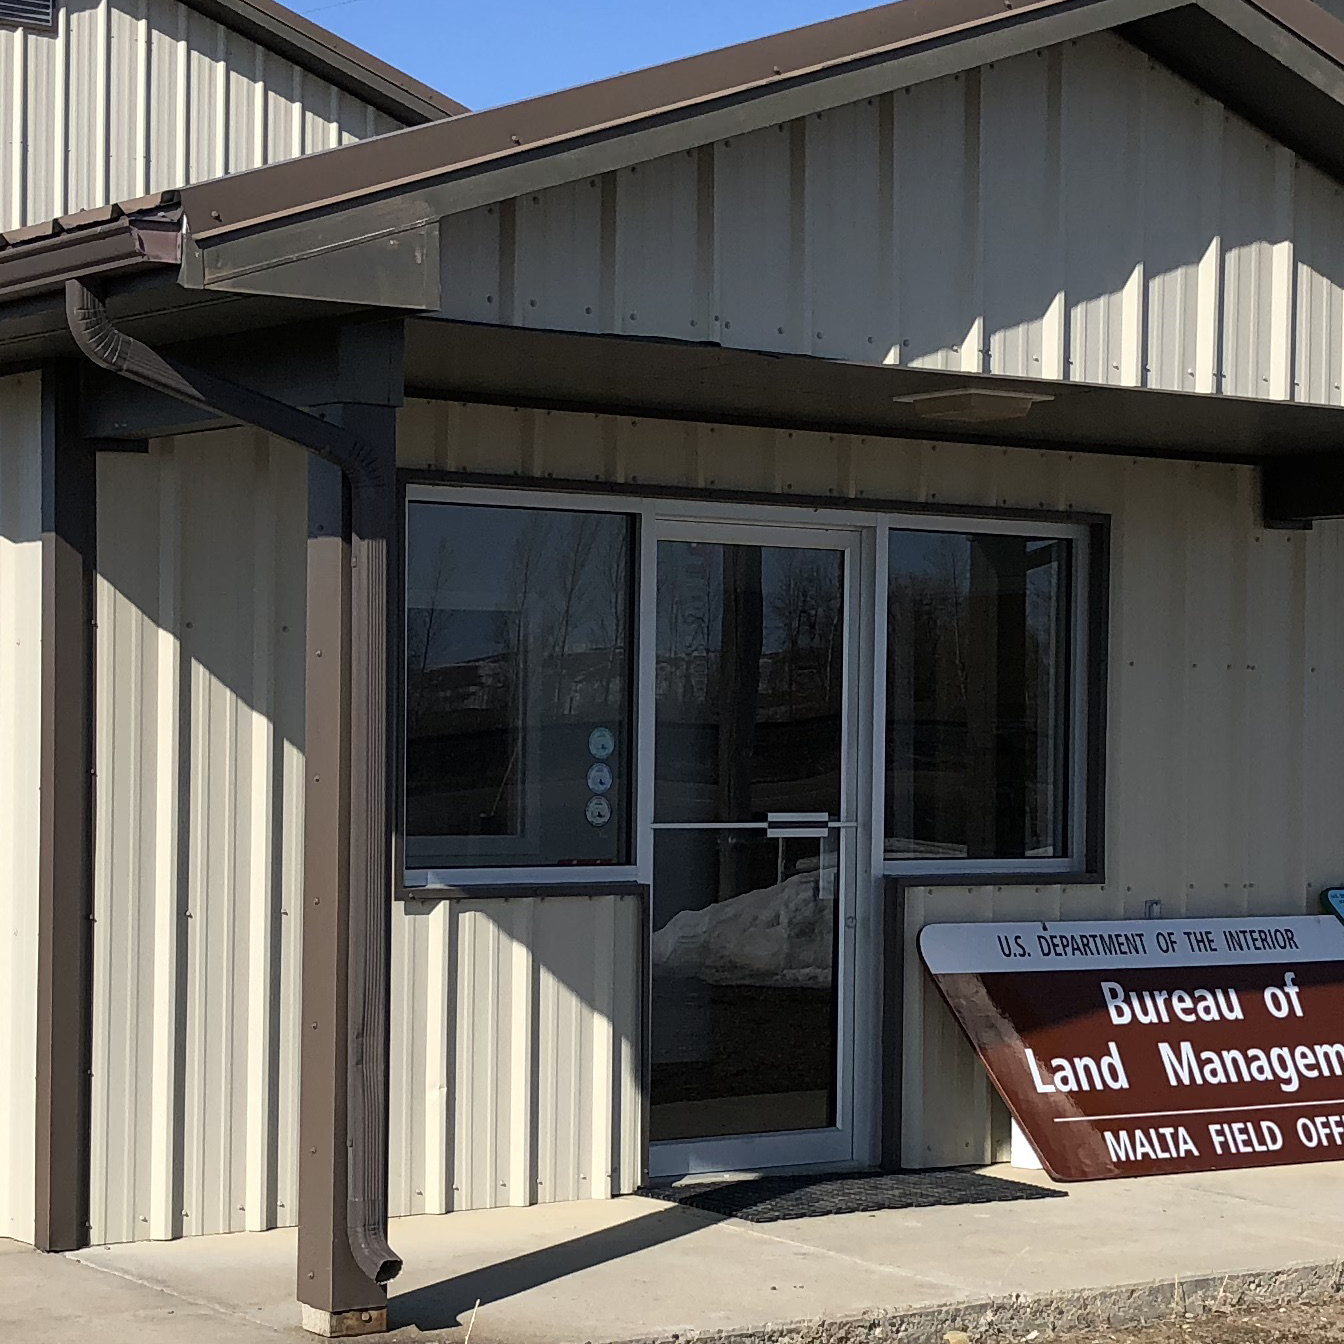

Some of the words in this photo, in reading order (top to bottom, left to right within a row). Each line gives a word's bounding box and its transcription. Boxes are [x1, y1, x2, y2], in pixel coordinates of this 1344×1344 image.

[997, 935, 1031, 957] U.S.
[1036, 933, 1147, 956] DEPARTMENT
[1156, 931, 1177, 953] OF
[1183, 930, 1218, 952] THE
[1222, 928, 1299, 951] INTERIOR
[1100, 981, 1244, 1025] Bureau
[1264, 972, 1304, 1017] of
[1024, 1041, 1130, 1094] Land
[1103, 1126, 1200, 1162] MALTA
[1207, 1120, 1283, 1155] FIELD
